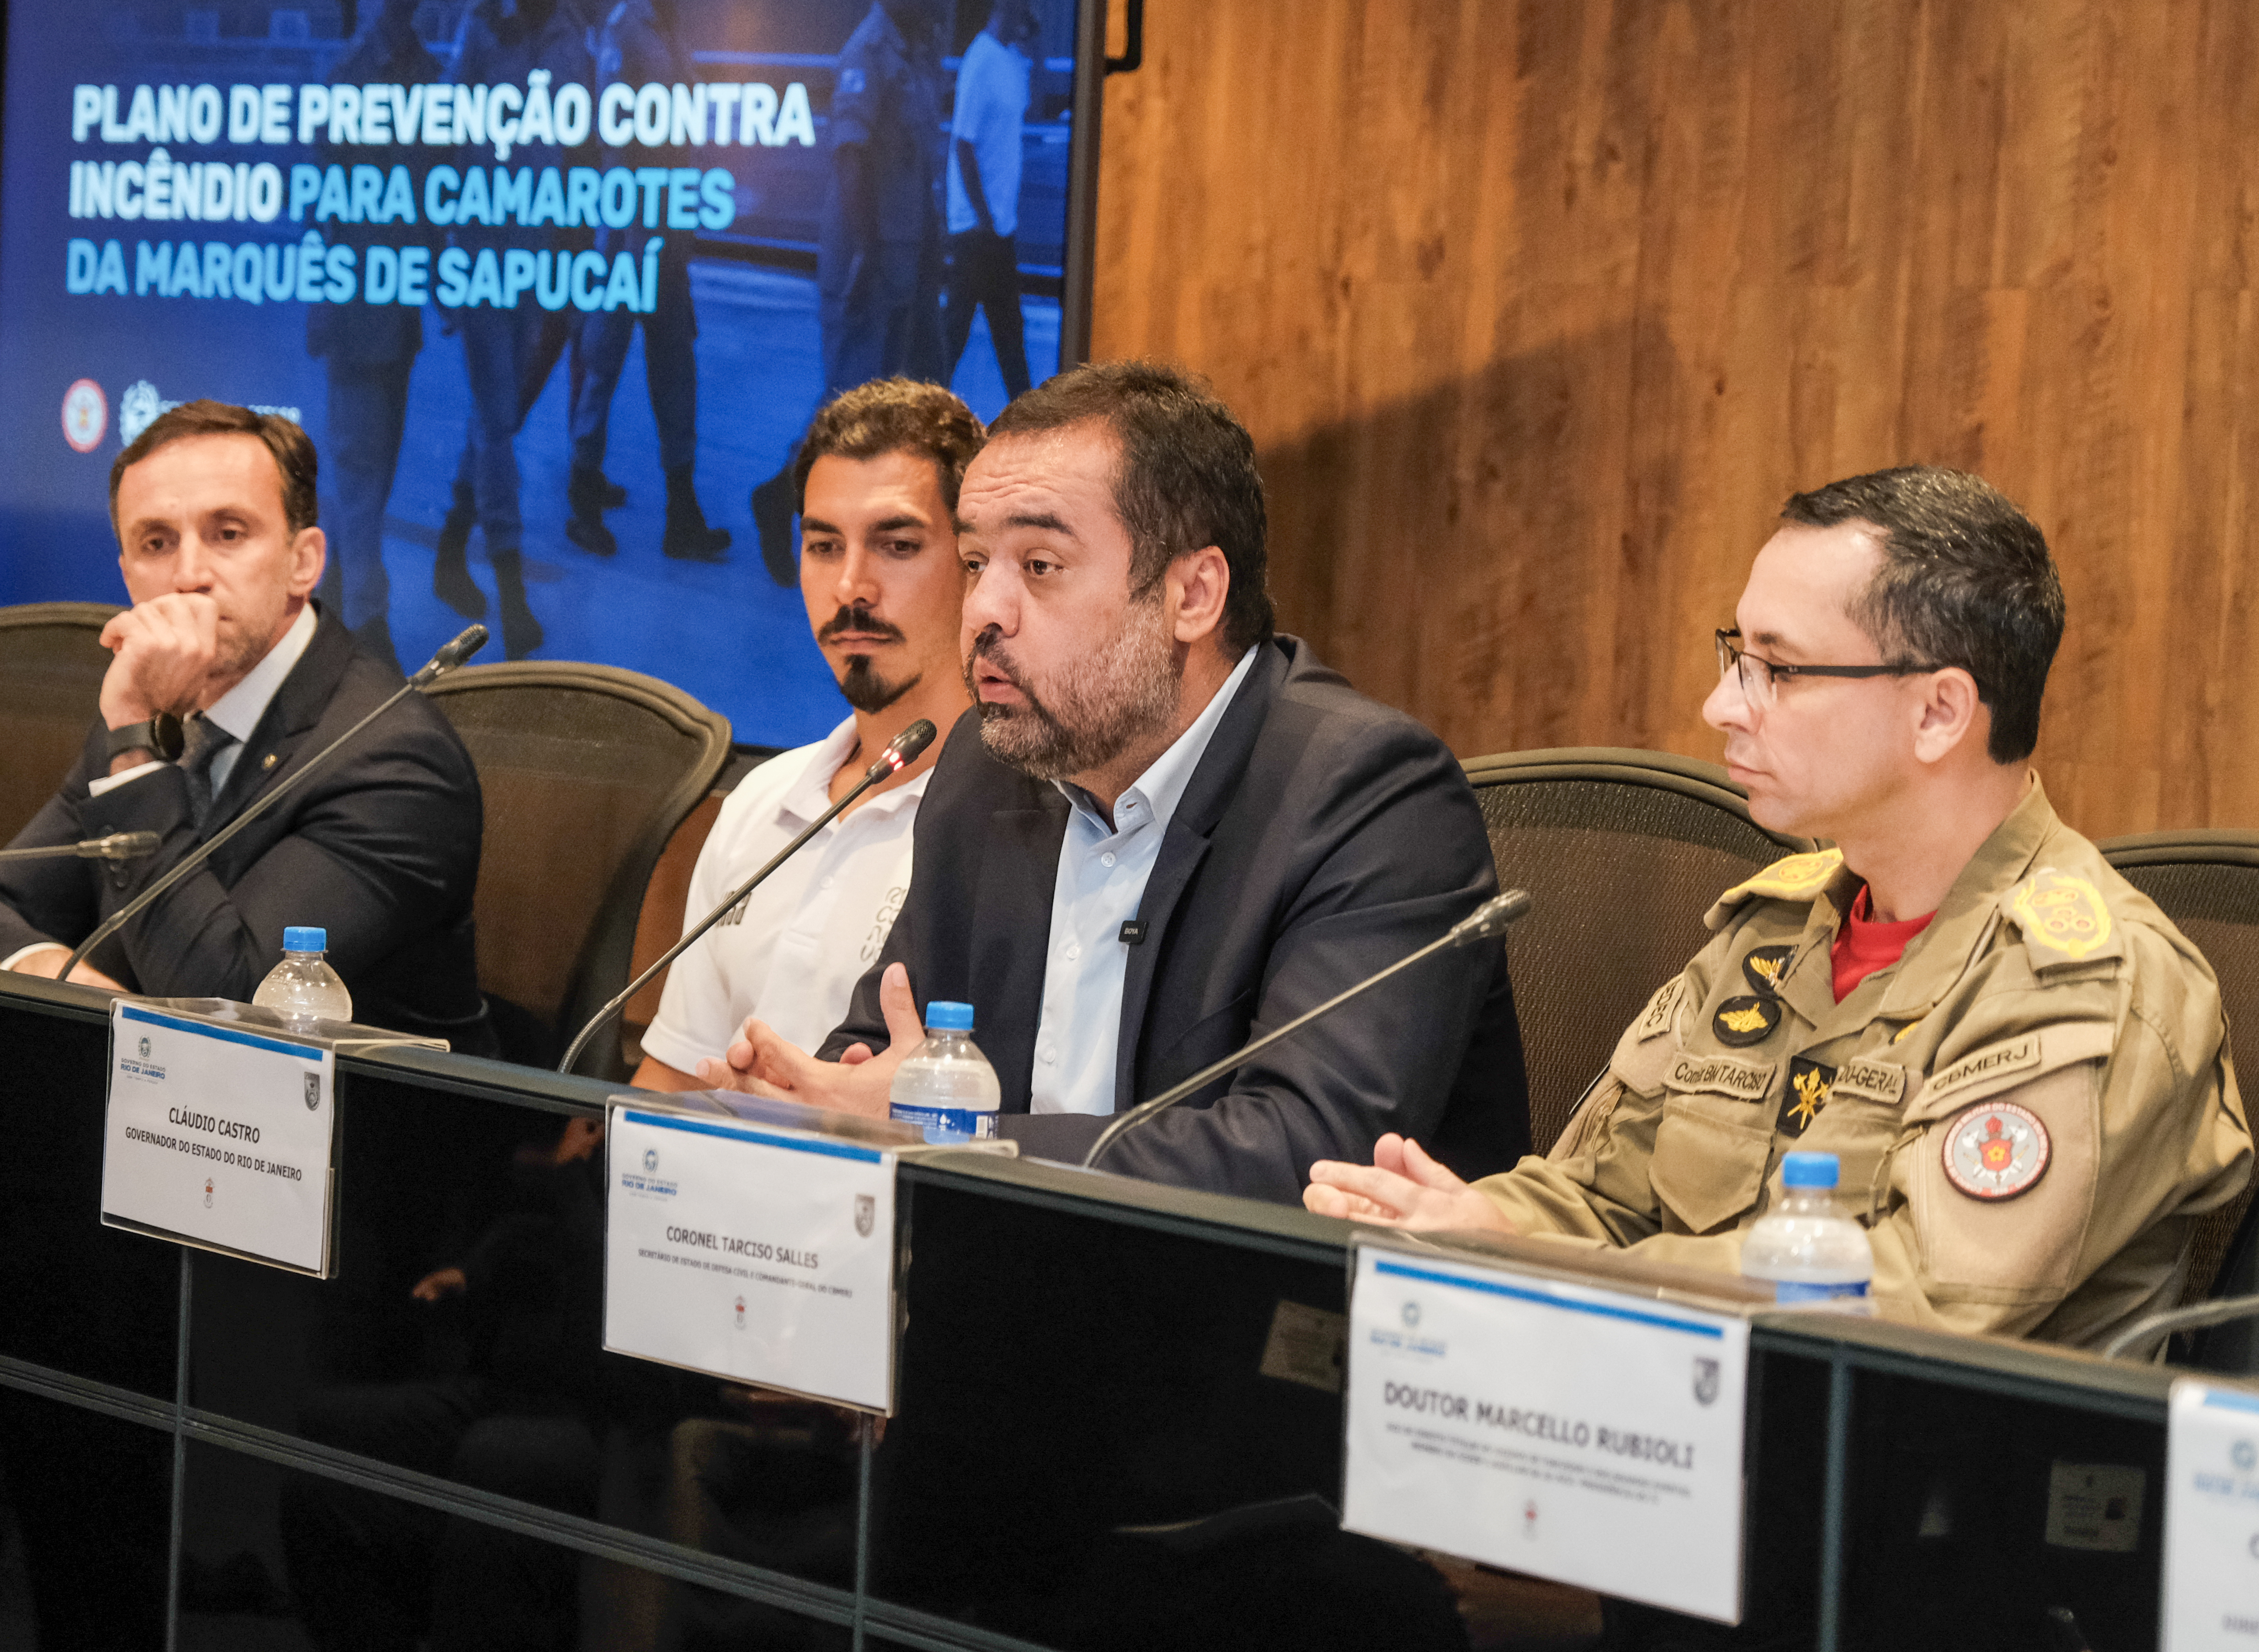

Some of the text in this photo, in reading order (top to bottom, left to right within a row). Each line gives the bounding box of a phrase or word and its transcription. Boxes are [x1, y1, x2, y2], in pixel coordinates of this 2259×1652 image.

[71, 69, 816, 161] PLANO DE PREVENÇÃO CONTRA
[69, 147, 736, 230] INCÊNDIO PARA CAMAROTES
[67, 229, 665, 313] DA MARQUÊS DE SAPUCAÍ
[141, 1069, 165, 1079] JANEIRO
[125, 1126, 302, 1181] GOVERNADOR DO ESTADO DO RIO DE JANEIRO
[169, 1106, 260, 1144] CLÁUDIO CASTRO
[667, 1225, 818, 1269] CORONEL TARCISO SALLES
[1384, 1380, 1470, 1422] DOUTOR
[1476, 1403, 1590, 1448] MARCELLO
[1597, 1426, 1695, 1471] RUBIOLI
